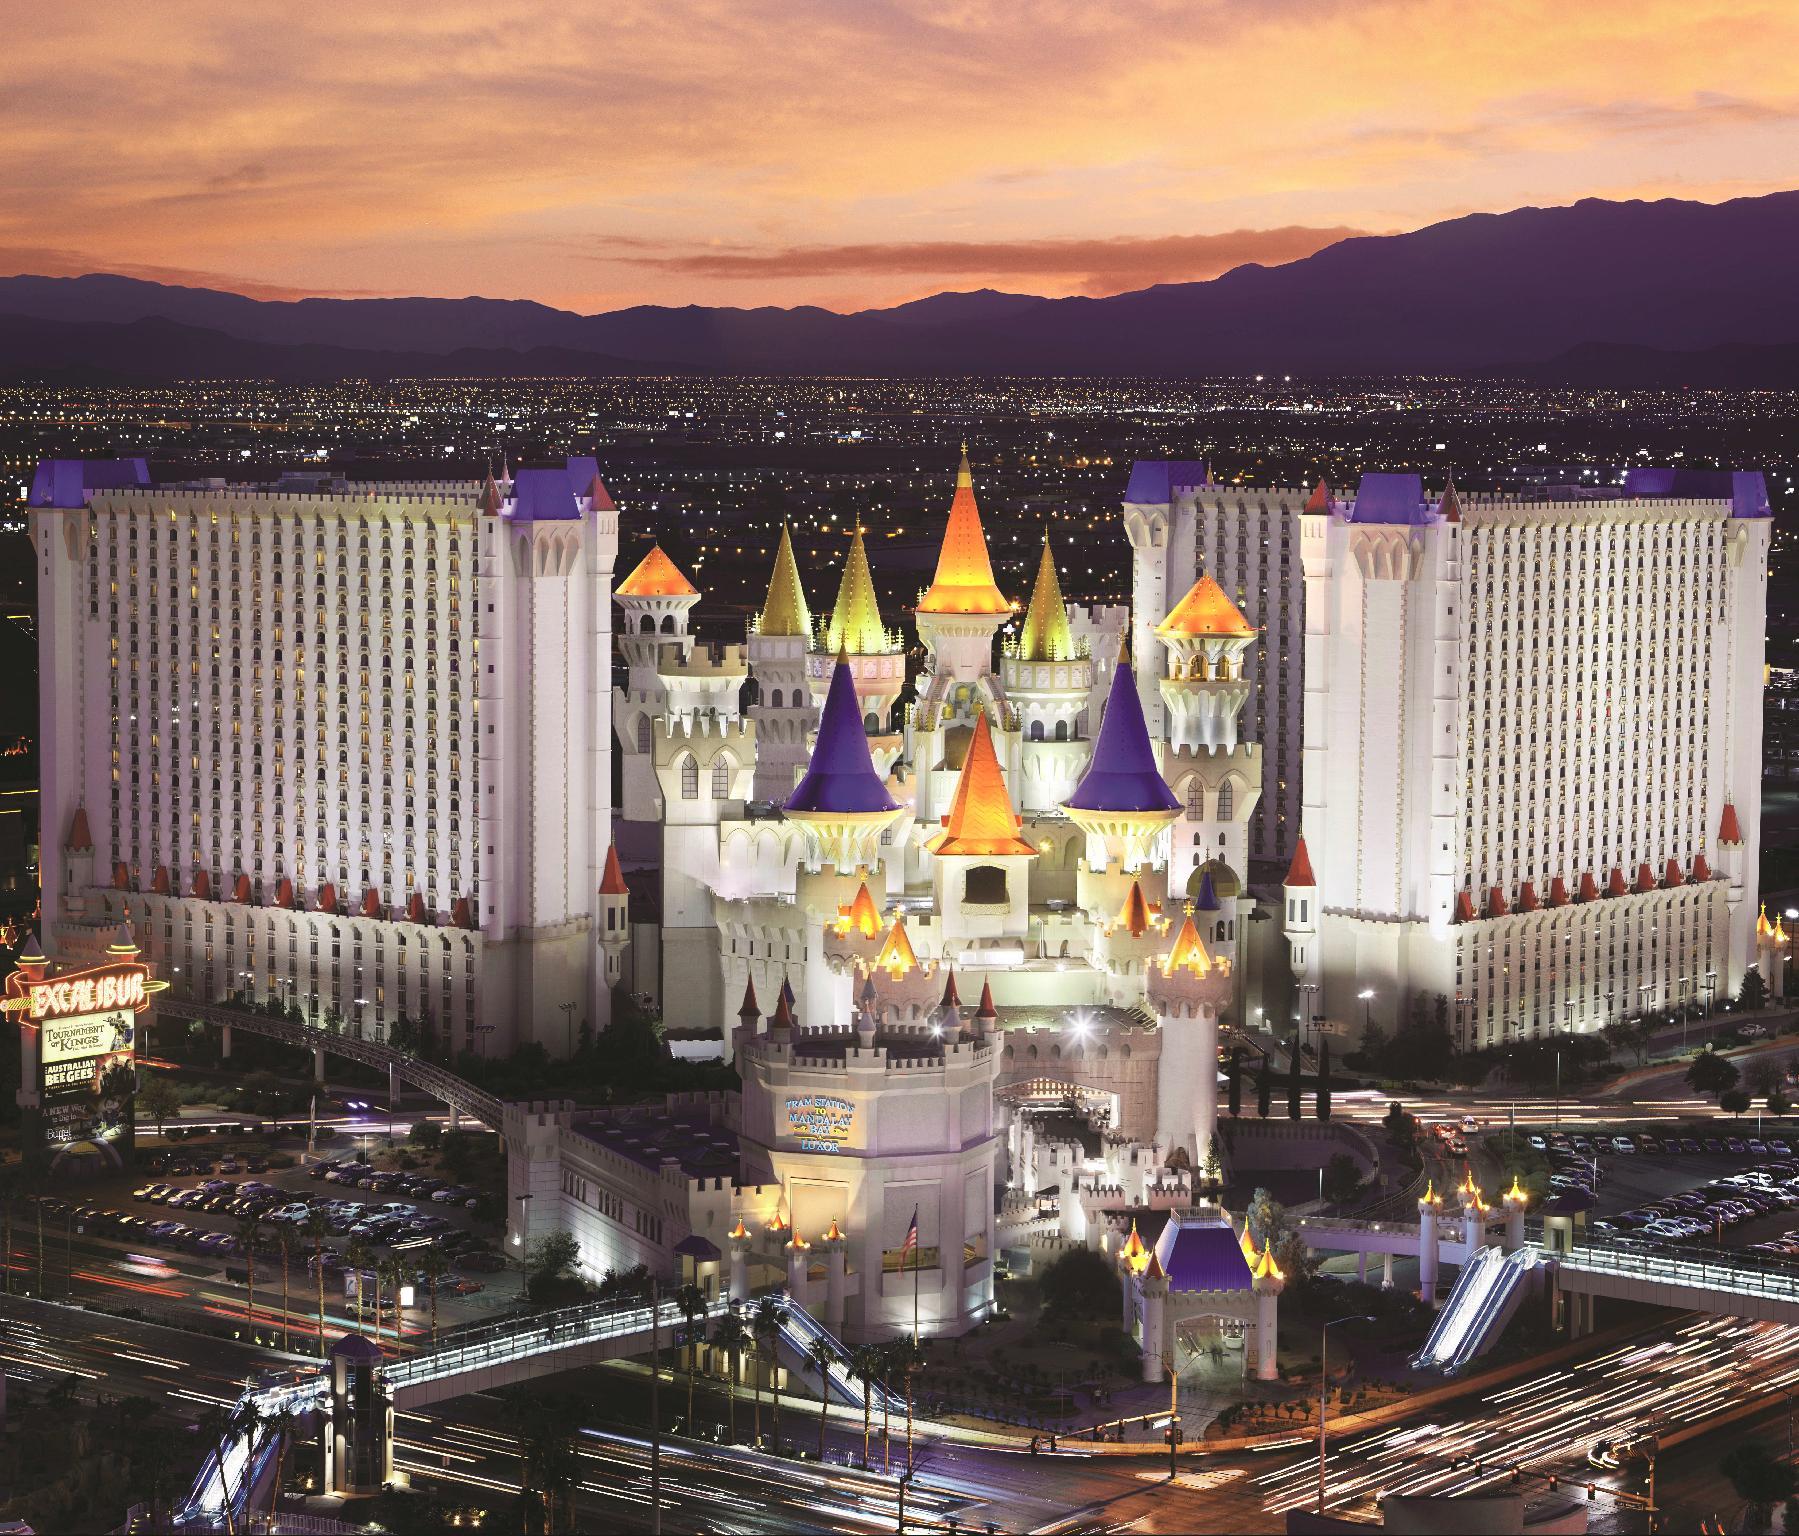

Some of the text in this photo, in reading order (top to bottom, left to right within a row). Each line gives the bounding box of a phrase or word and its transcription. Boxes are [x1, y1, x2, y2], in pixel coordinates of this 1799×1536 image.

[32, 973, 144, 1017] EXCALIBUR
[47, 1059, 96, 1074] AUSTRALIAN
[45, 1072, 66, 1086] BEE
[66, 1067, 93, 1083] GEES
[785, 1098, 855, 1113] TRAM STATION
[815, 1107, 827, 1115] TO
[789, 1113, 852, 1126] MANDALAY
[809, 1124, 831, 1135] BAY
[801, 1138, 840, 1153] LUXOR
